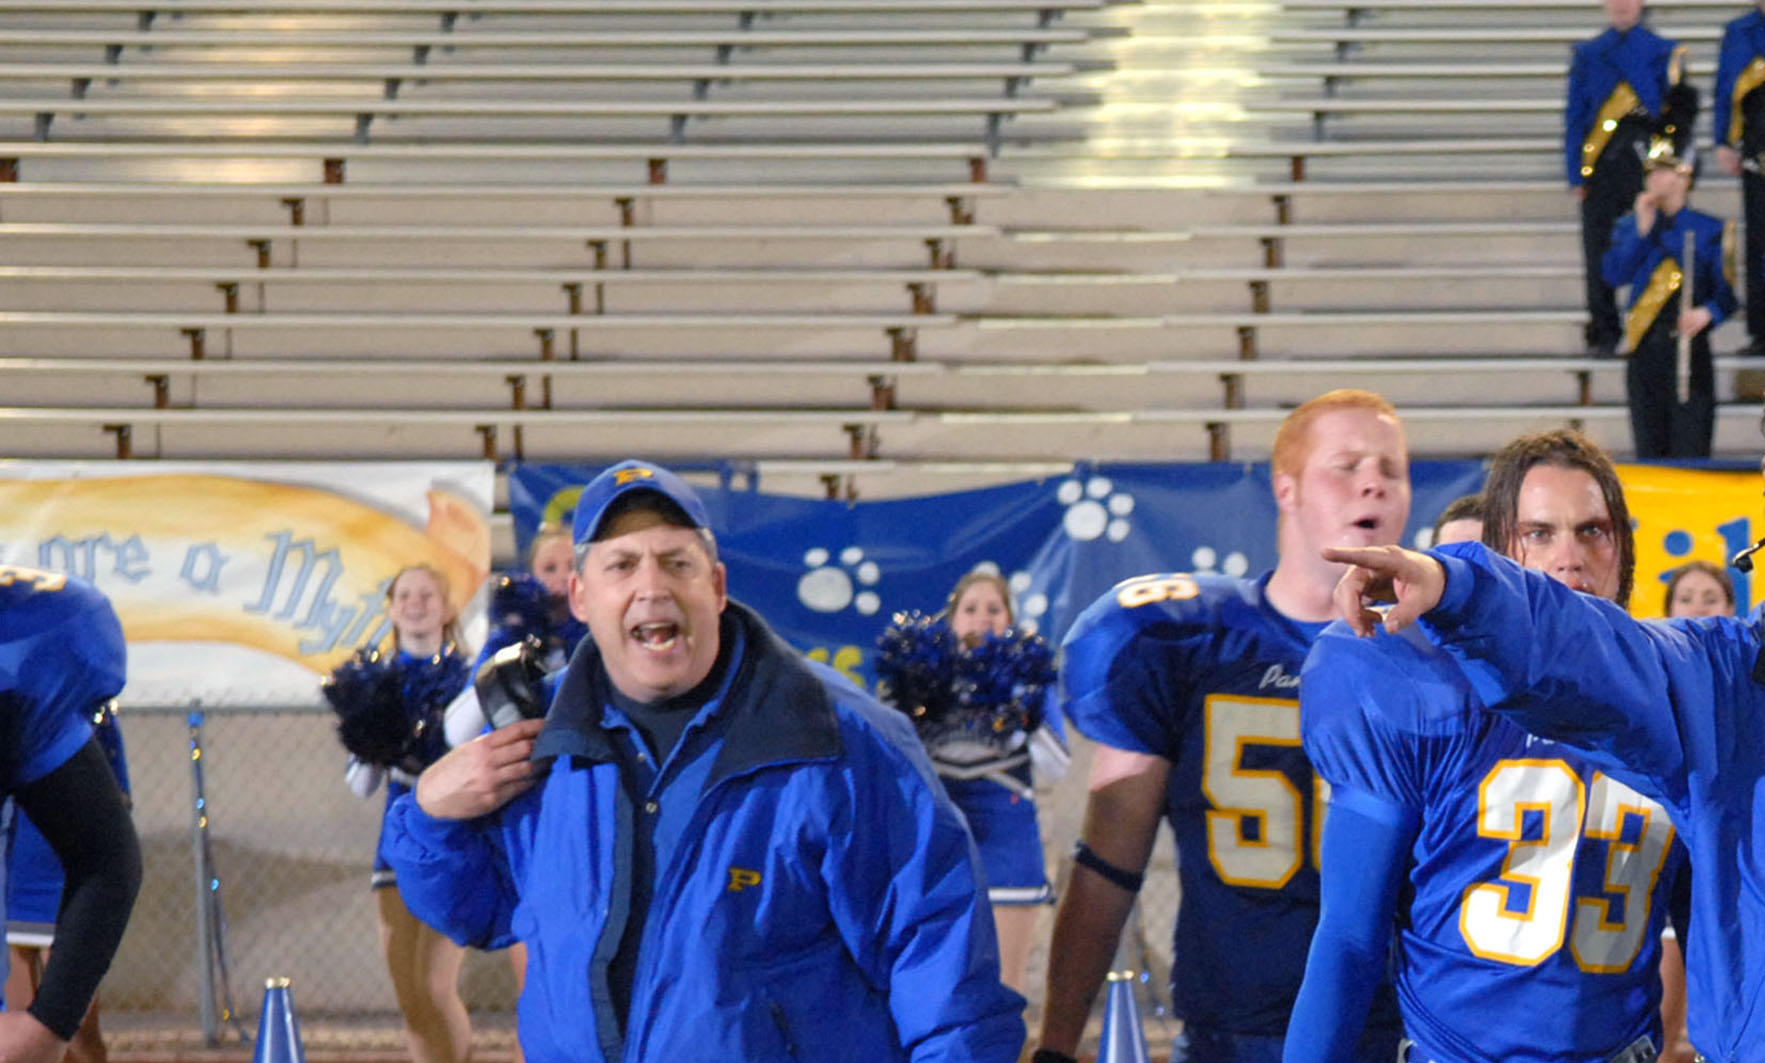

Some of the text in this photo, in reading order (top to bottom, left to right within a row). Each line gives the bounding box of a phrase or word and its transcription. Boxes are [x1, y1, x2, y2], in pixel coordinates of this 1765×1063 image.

[727, 867, 762, 891] P
[1202, 693, 1331, 889] 5
[1459, 758, 1676, 974] 33
